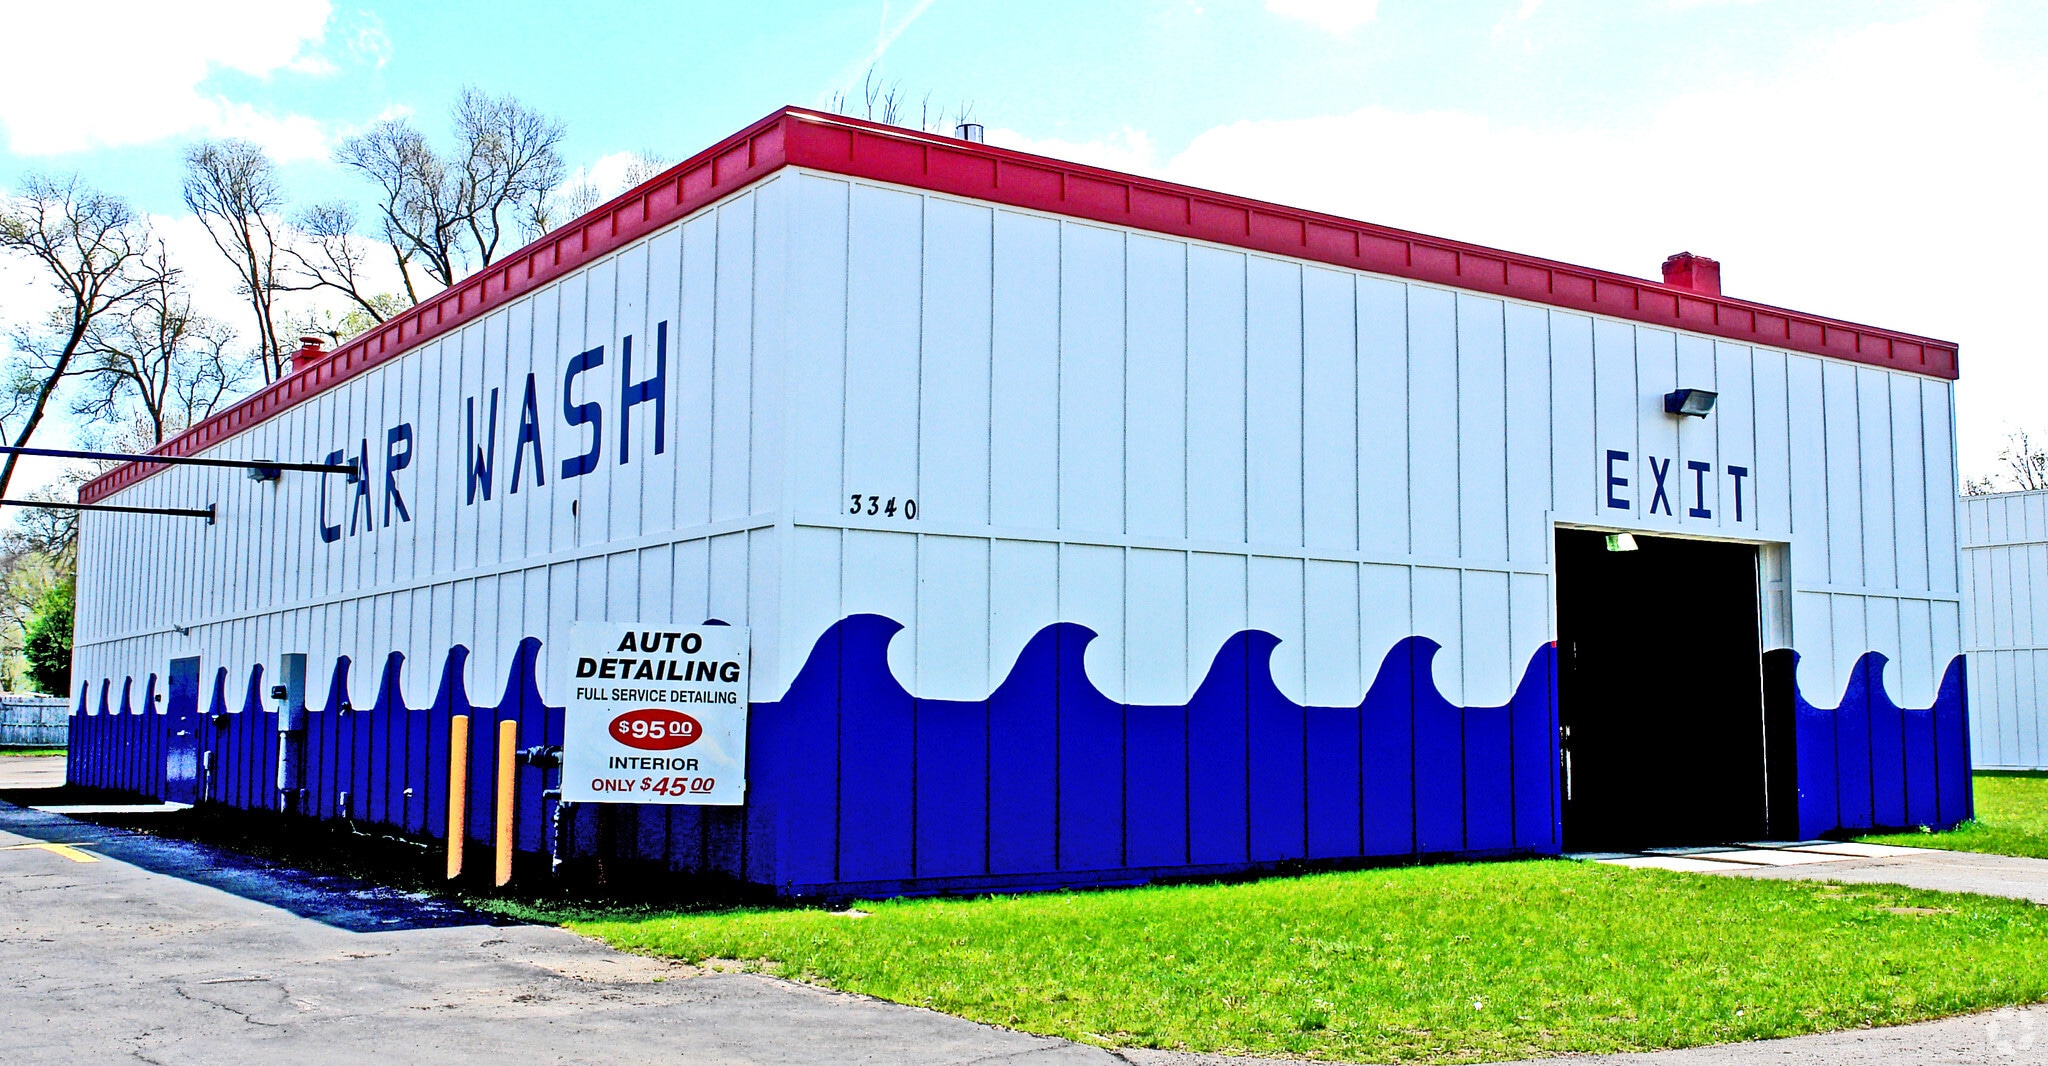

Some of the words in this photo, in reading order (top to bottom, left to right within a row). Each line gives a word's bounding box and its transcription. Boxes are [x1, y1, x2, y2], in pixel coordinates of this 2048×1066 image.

[320, 422, 412, 543] CAR
[466, 320, 668, 506] WASH
[1606, 449, 1748, 522] EXIT
[850, 494, 917, 520] 3340
[617, 631, 702, 654] AUTO
[575, 657, 741, 683] DETAILING
[576, 687, 608, 700] FULL
[611, 688, 667, 702] SERVICE
[670, 690, 737, 704] DETAILING
[609, 756, 699, 771] INTERIOR
[591, 778, 636, 792] ONLY
